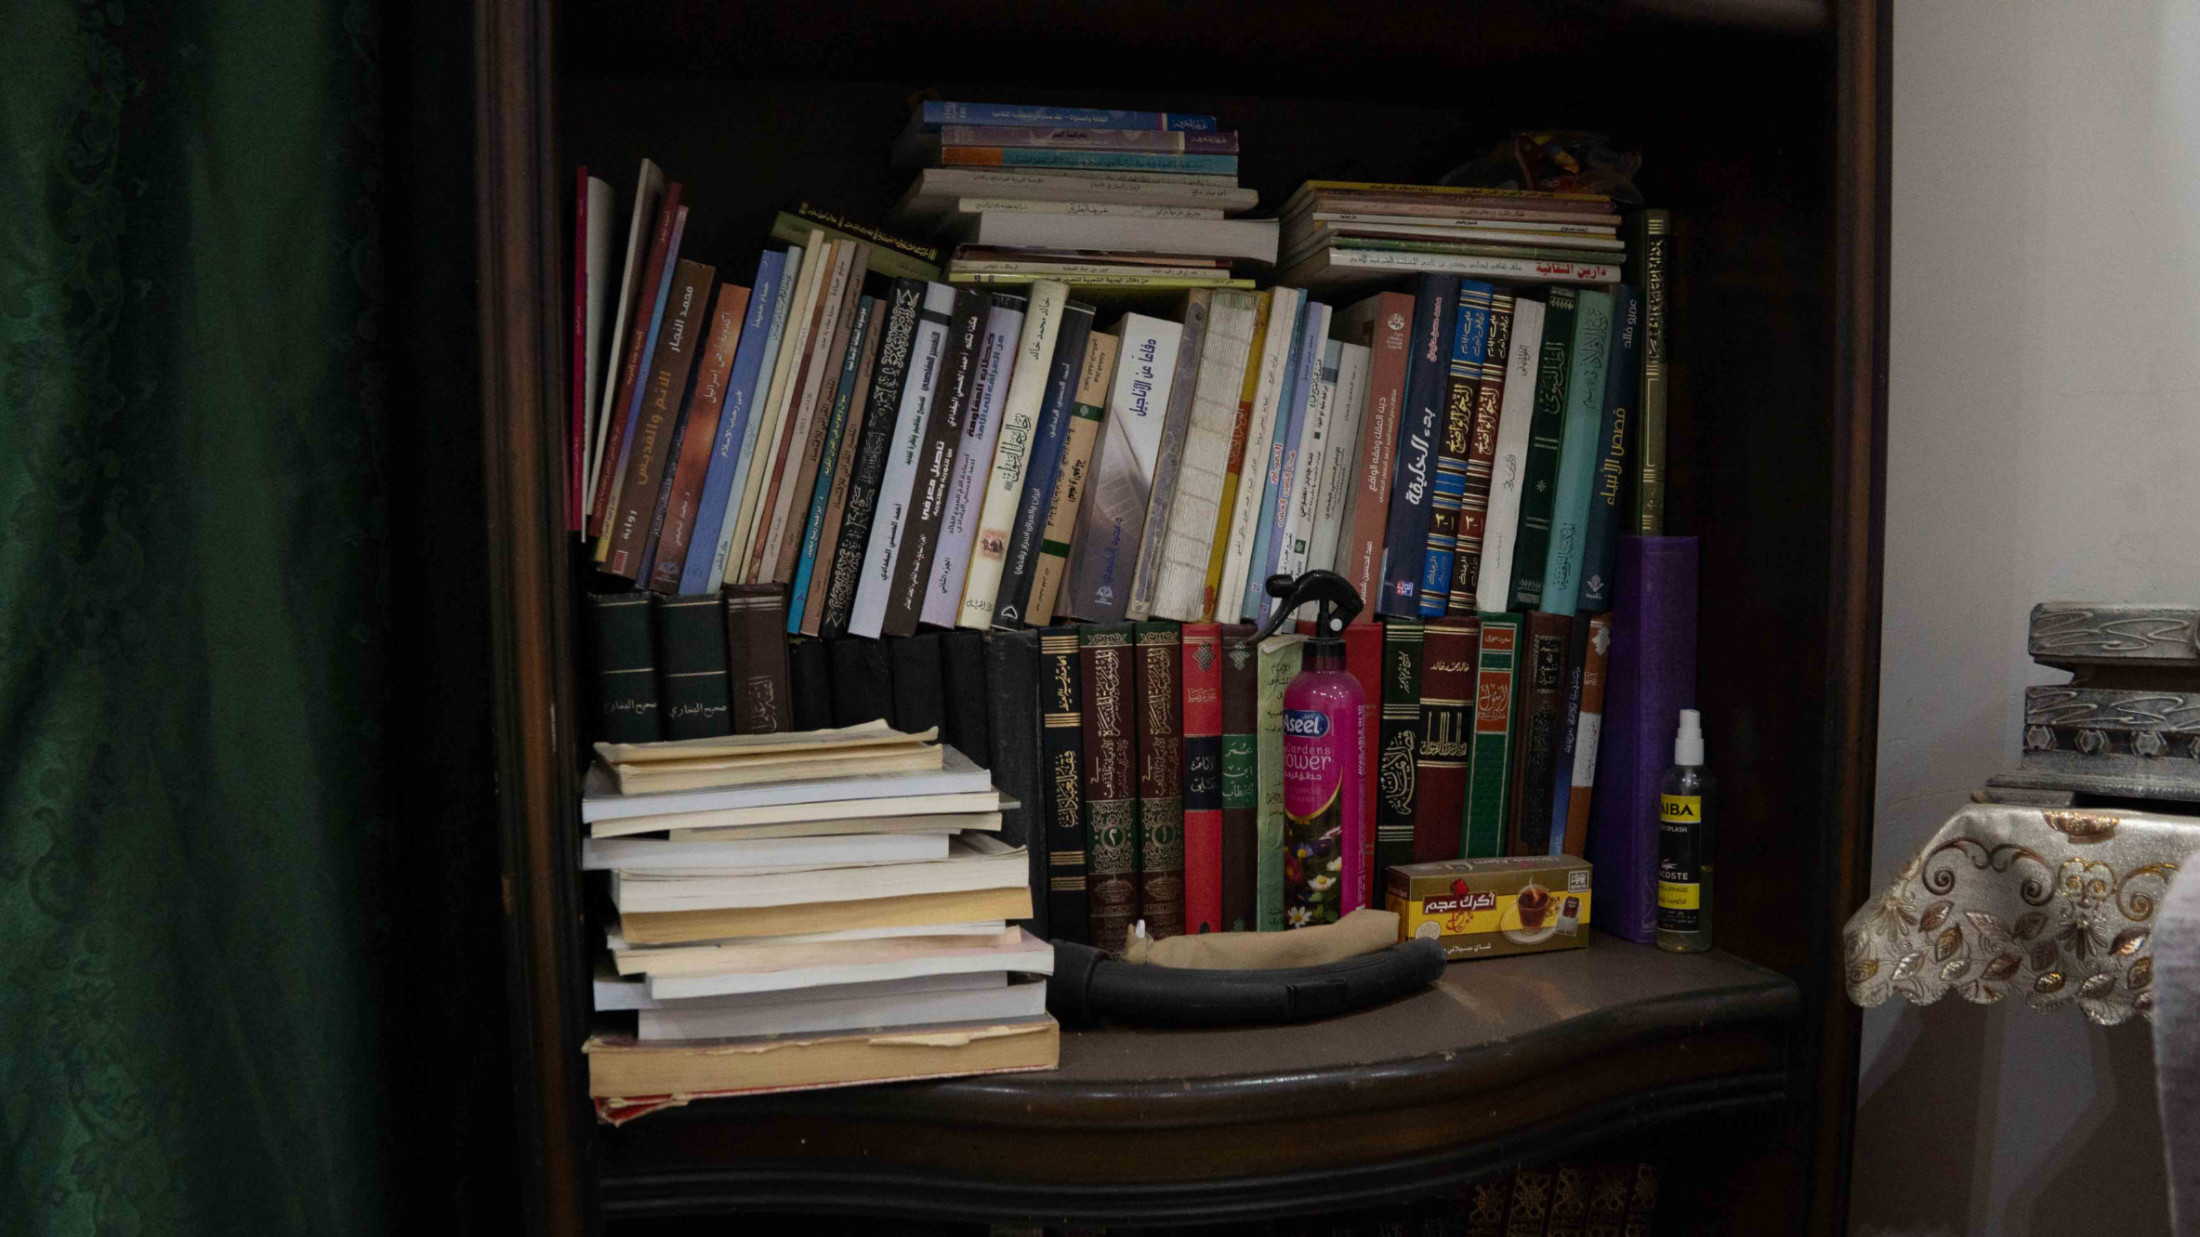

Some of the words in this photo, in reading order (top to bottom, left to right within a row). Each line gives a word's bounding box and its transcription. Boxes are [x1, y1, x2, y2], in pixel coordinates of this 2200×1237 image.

[679, 285, 693, 317] محمد
[1626, 299, 1637, 325] عمرو
[668, 318, 684, 352] النجار
[1037, 316, 1046, 340] محمد
[1621, 326, 1633, 347] خالد
[929, 330, 940, 357] التفسير
[979, 332, 995, 380] خطاب
[967, 382, 984, 437] المقاومة
[1129, 379, 1151, 416] الأناجيل
[1422, 407, 1435, 437] بدء
[1610, 407, 1625, 456] قصص
[638, 414, 663, 485] والقديس
[1367, 464, 1379, 492] الواقع
[1405, 433, 1429, 504] الخليقة
[1599, 458, 1621, 505] الأنبياء
[622, 509, 637, 539] رواية
[889, 521, 898, 548] الحسني
[880, 548, 891, 580] البغدادي
[668, 703, 704, 720] البخاري
[1284, 714, 1320, 734] Aseel
[1108, 829, 1120, 845] ٢
[1659, 872, 1689, 880] COSTE
[1424, 901, 1458, 914] عجم
